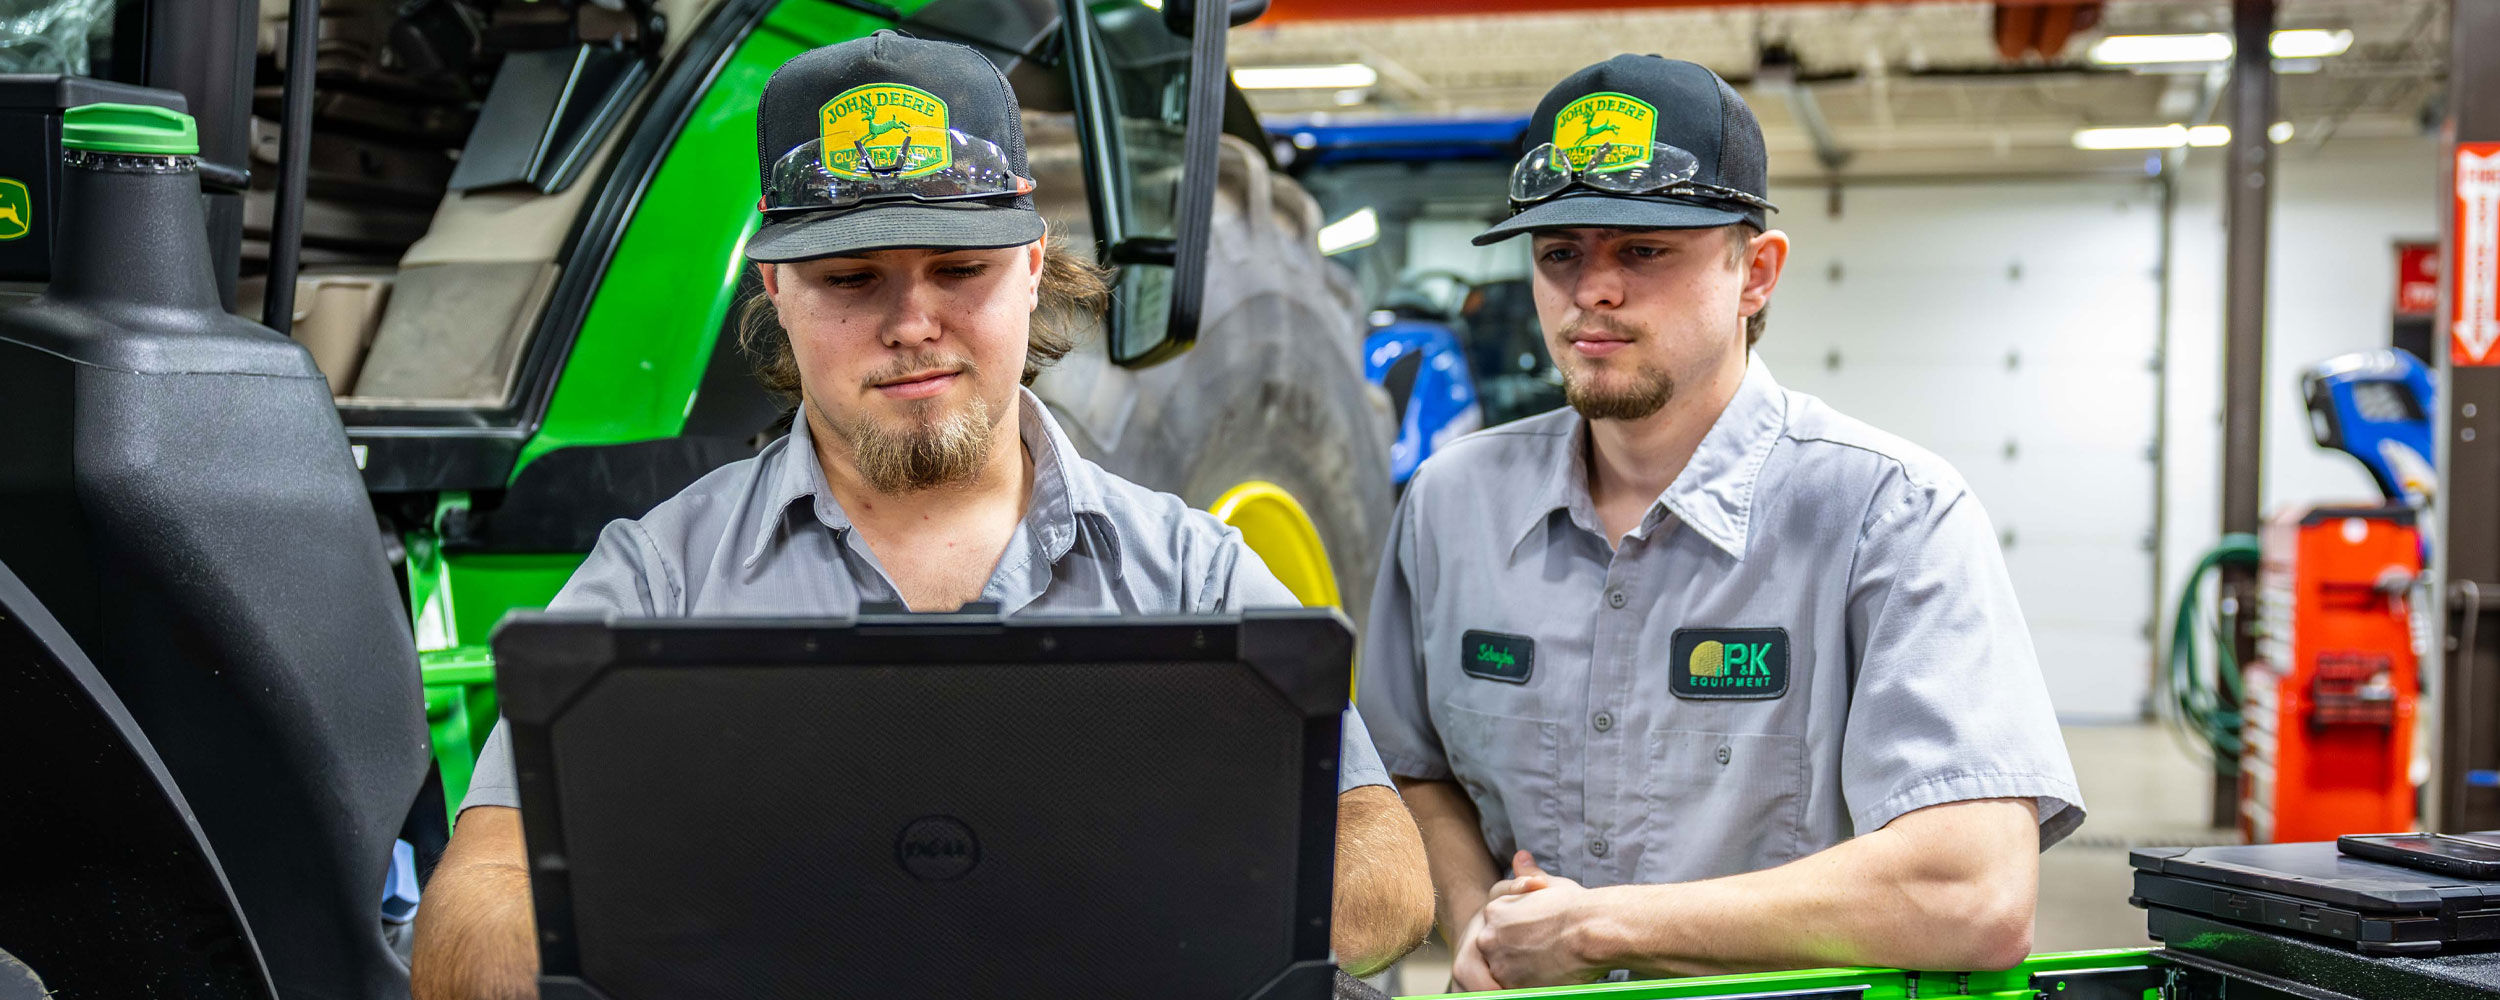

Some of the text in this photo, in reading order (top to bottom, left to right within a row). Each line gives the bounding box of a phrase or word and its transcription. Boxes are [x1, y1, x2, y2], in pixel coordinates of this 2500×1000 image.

[828, 92, 936, 124] JOHN DEERE
[1560, 99, 1647, 128] JOHN DEERE
[833, 147, 893, 164] QUAITY
[1723, 643, 1773, 676] P&K
[1689, 677, 1772, 687] EQUIPMENT
